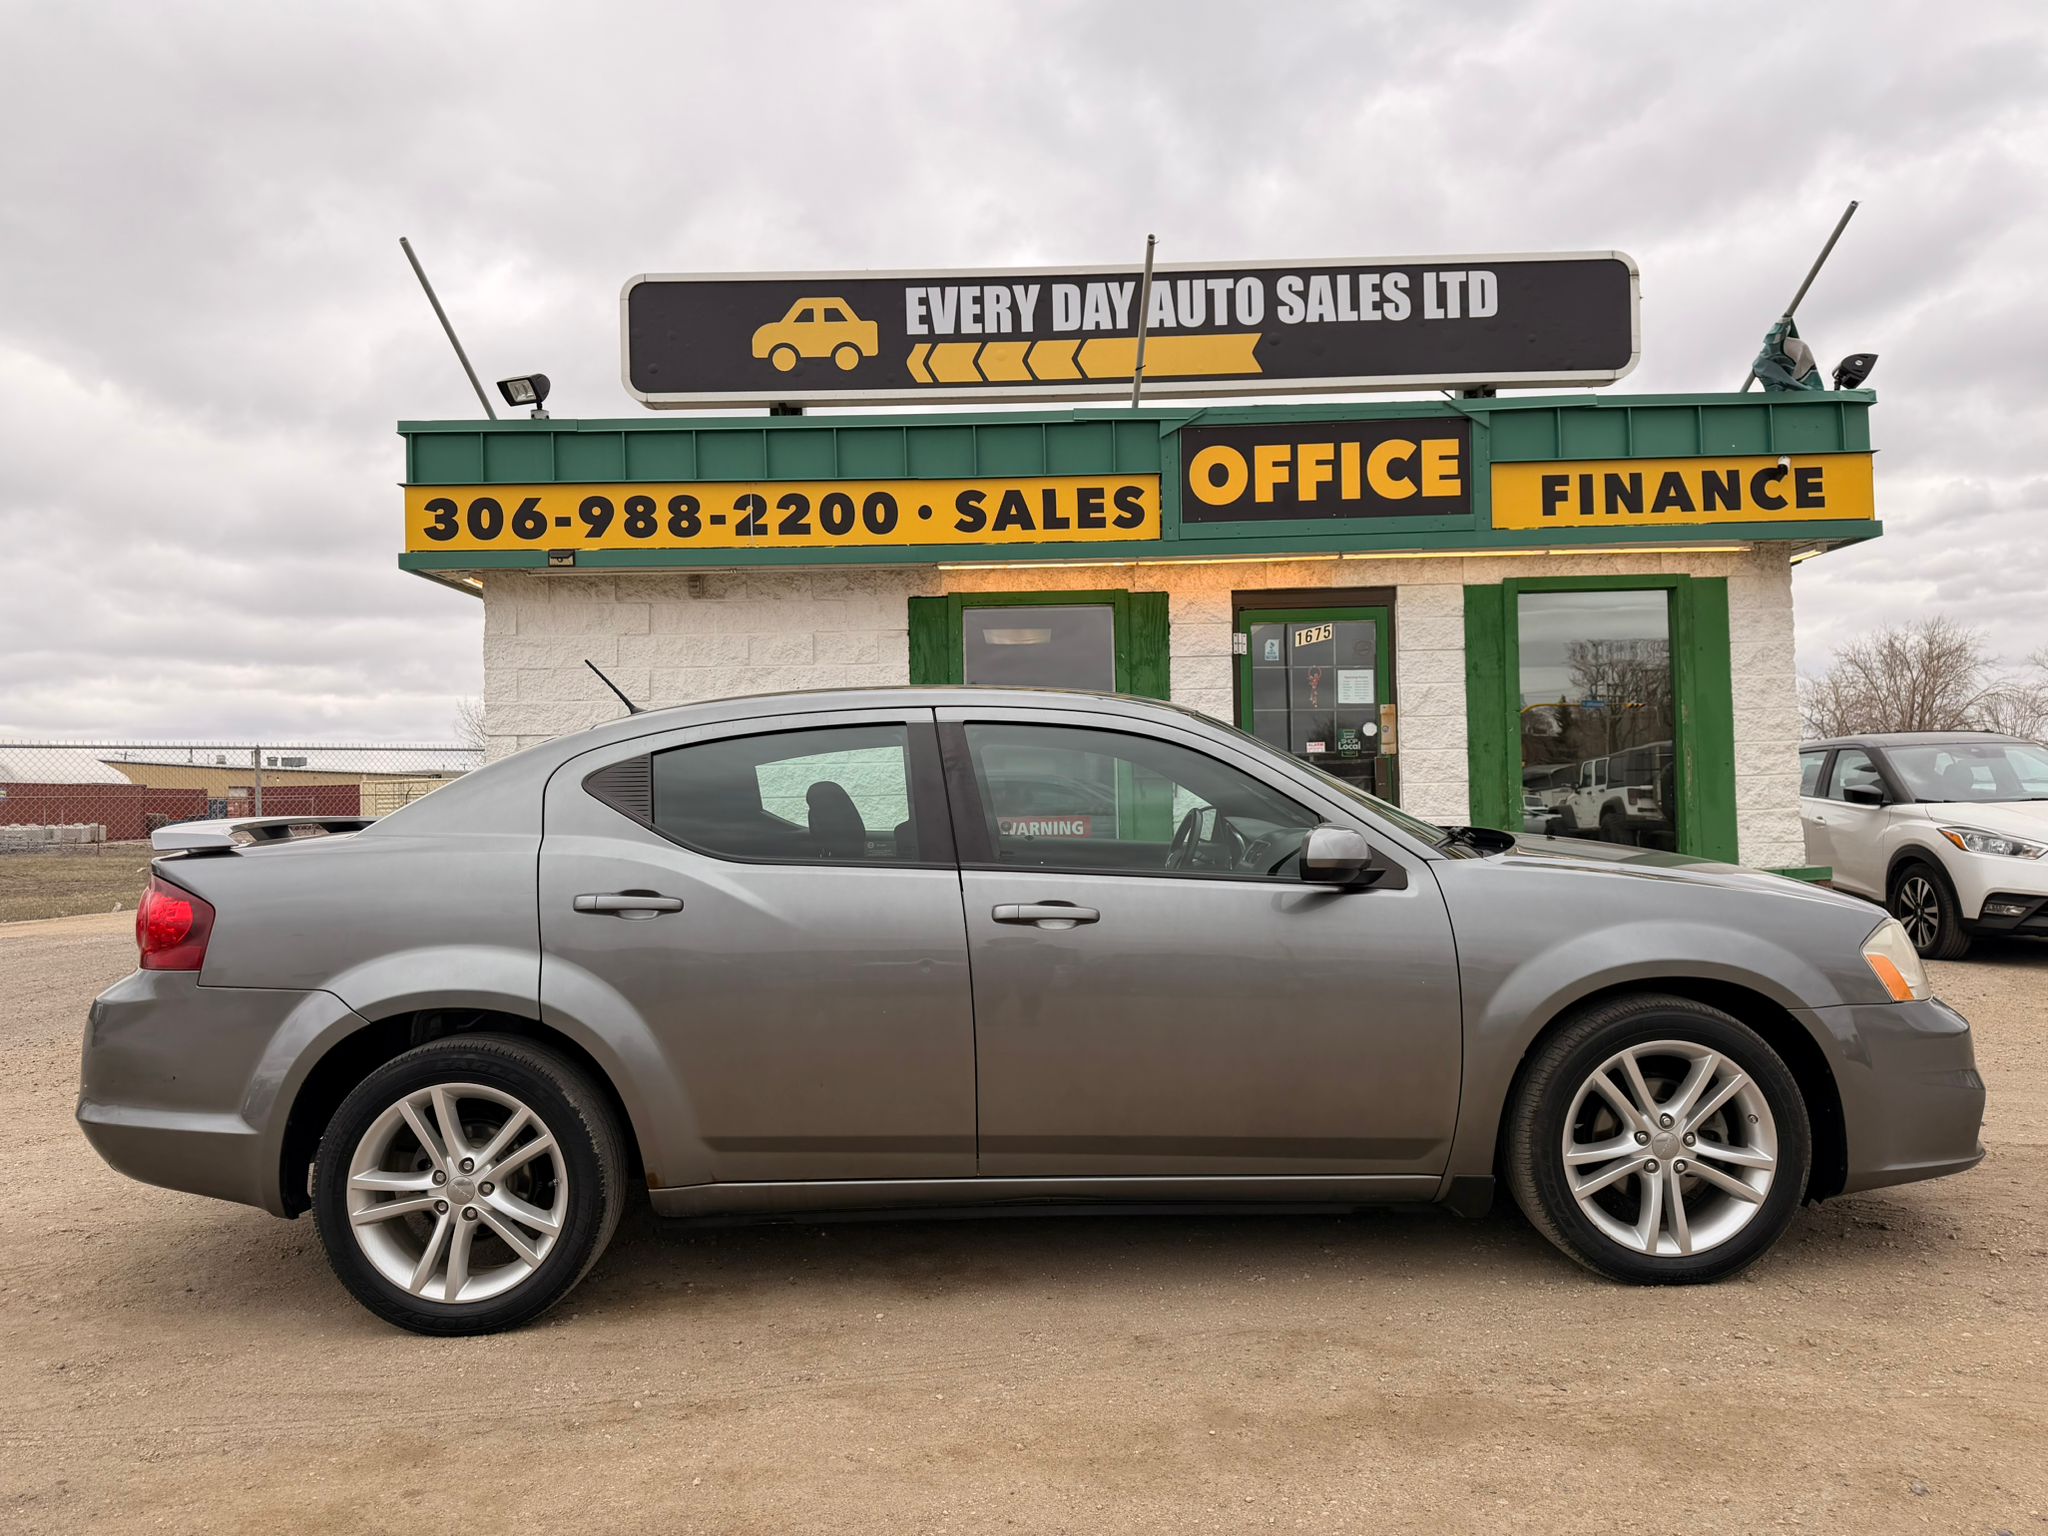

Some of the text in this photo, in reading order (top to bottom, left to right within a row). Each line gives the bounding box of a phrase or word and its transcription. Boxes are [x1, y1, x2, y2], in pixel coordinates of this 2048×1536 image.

[905, 270, 1498, 335] EVERY DAY AUTO SALES LTD
[1189, 438, 1462, 506] OFFICE
[1541, 466, 1826, 516] FINANCE
[423, 486, 1145, 542] 306-988-2200 SALES
[1297, 625, 1331, 645] 1675
[1338, 741, 1361, 750] Local
